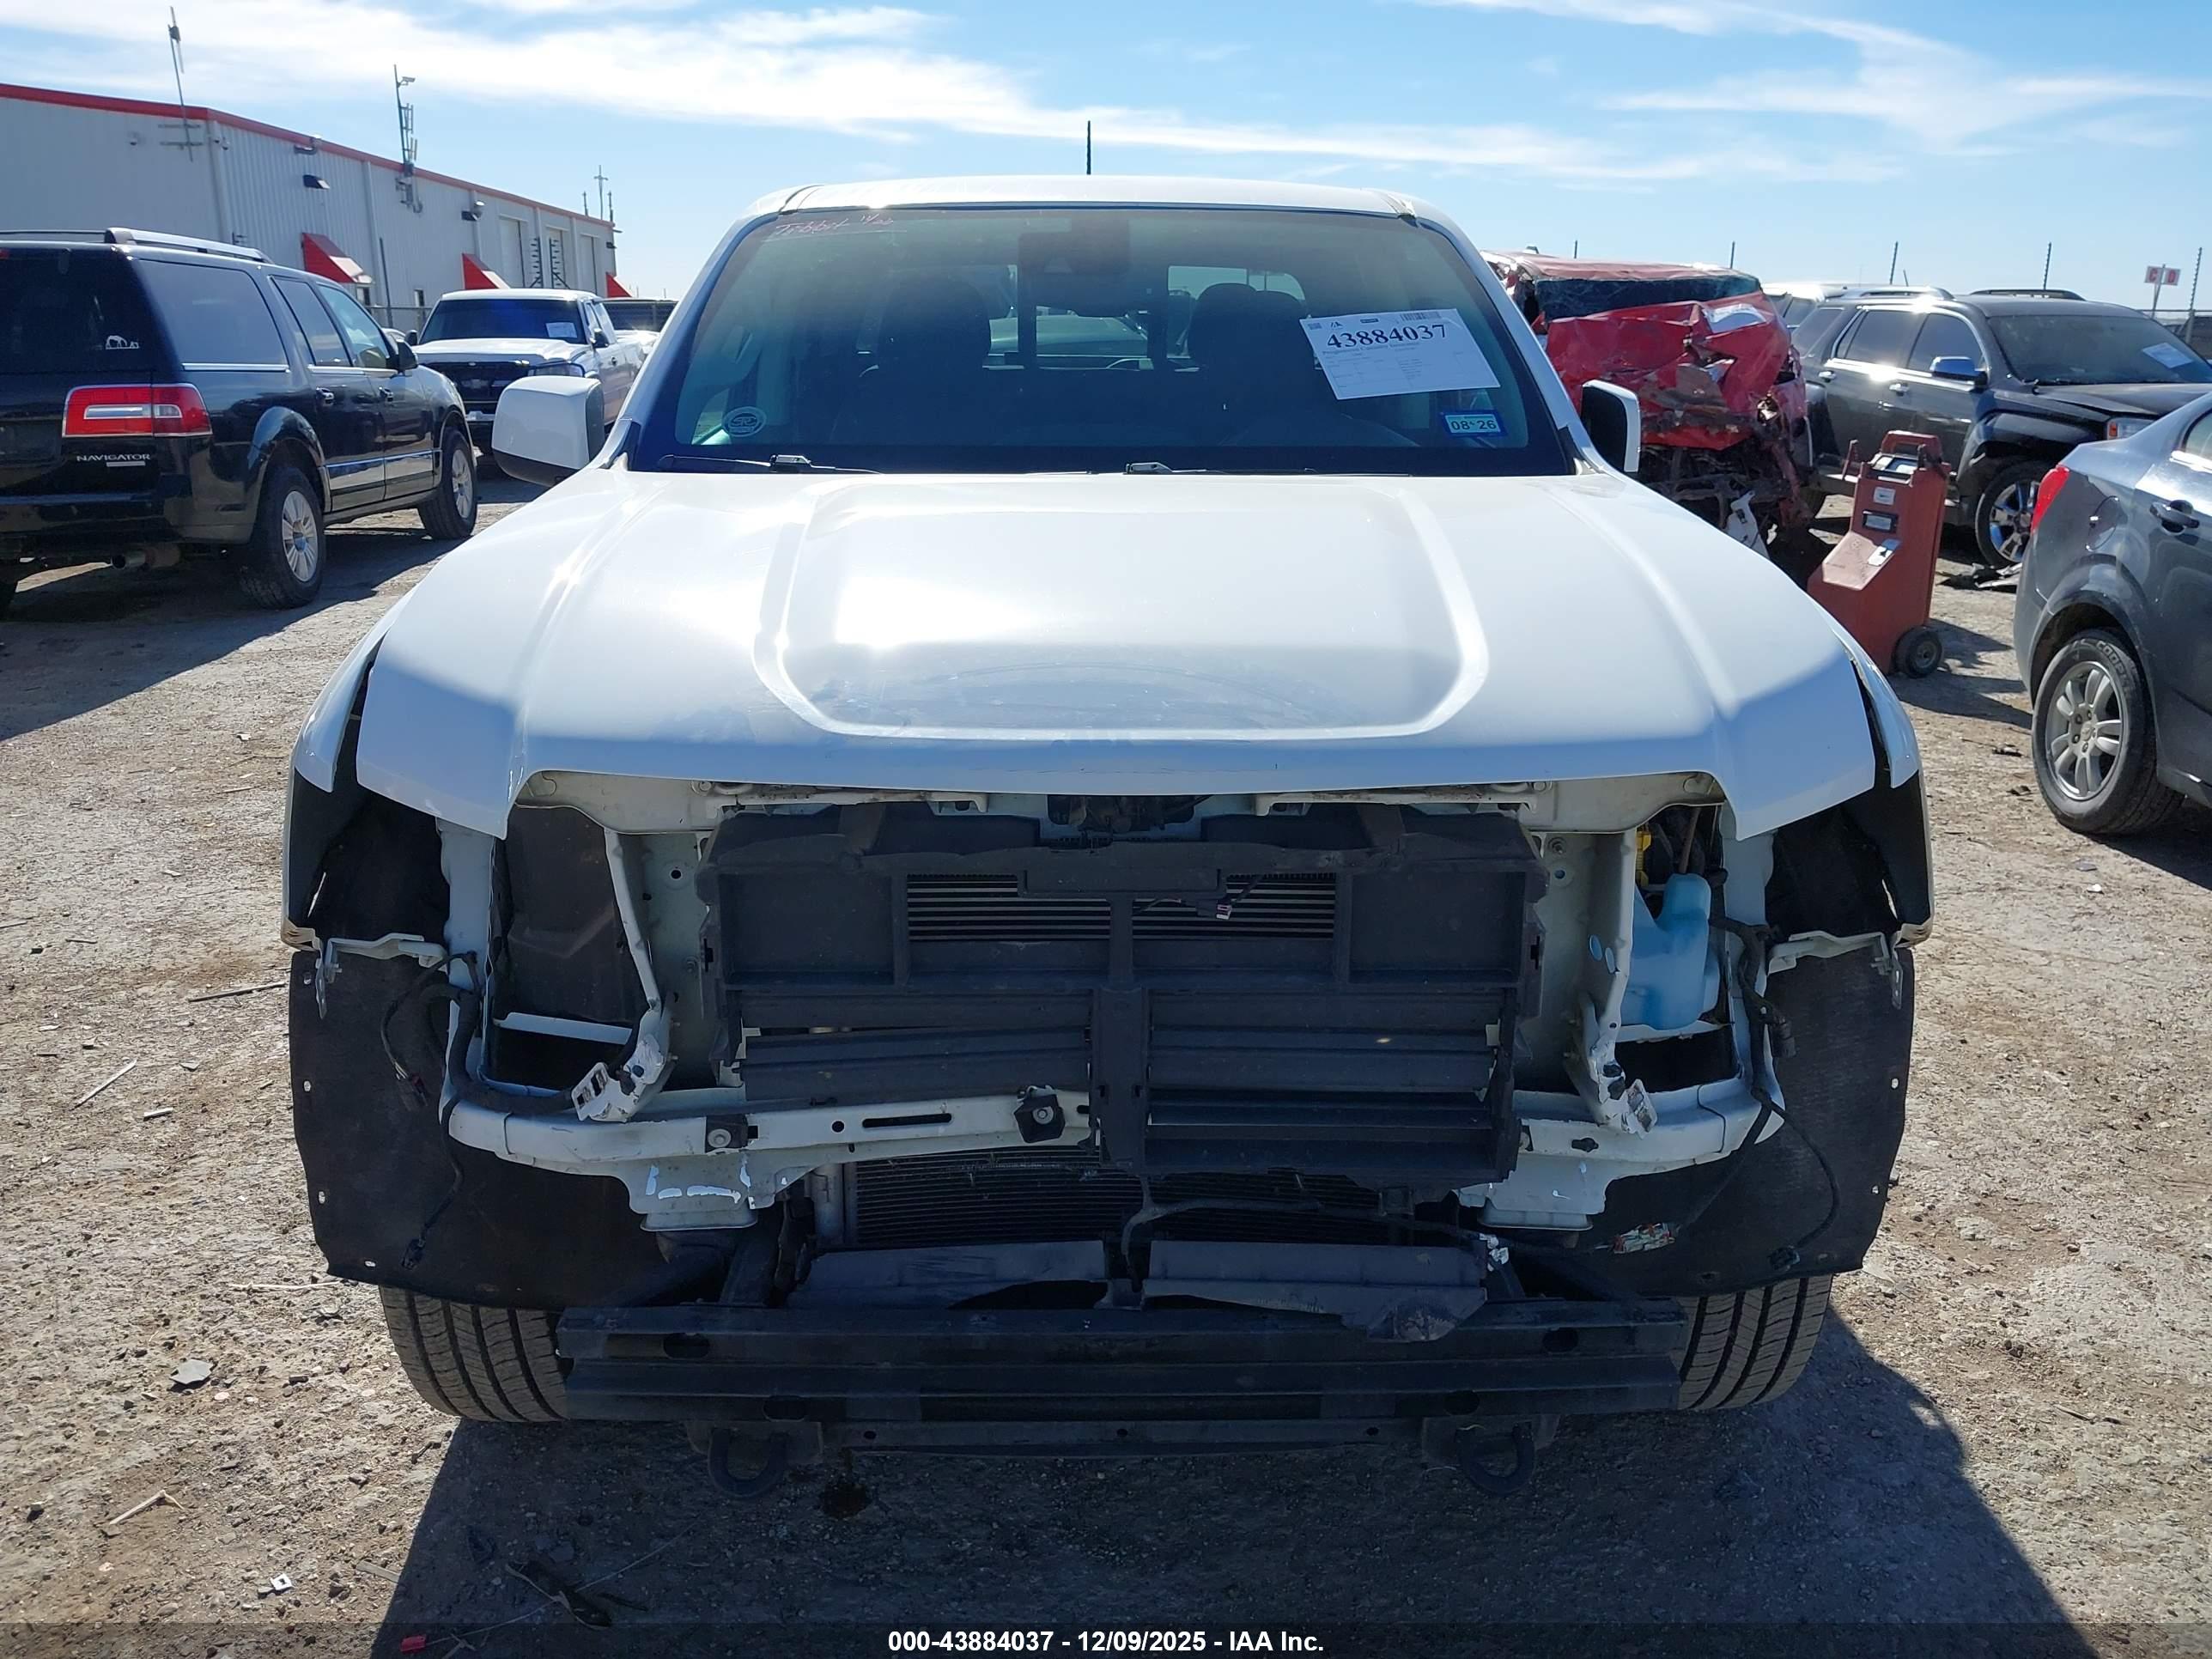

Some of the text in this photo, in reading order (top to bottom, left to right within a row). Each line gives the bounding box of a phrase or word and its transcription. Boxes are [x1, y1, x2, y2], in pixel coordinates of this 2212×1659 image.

[1327, 324, 1446, 348] 43884037
[1451, 420, 1497, 430] 08 26
